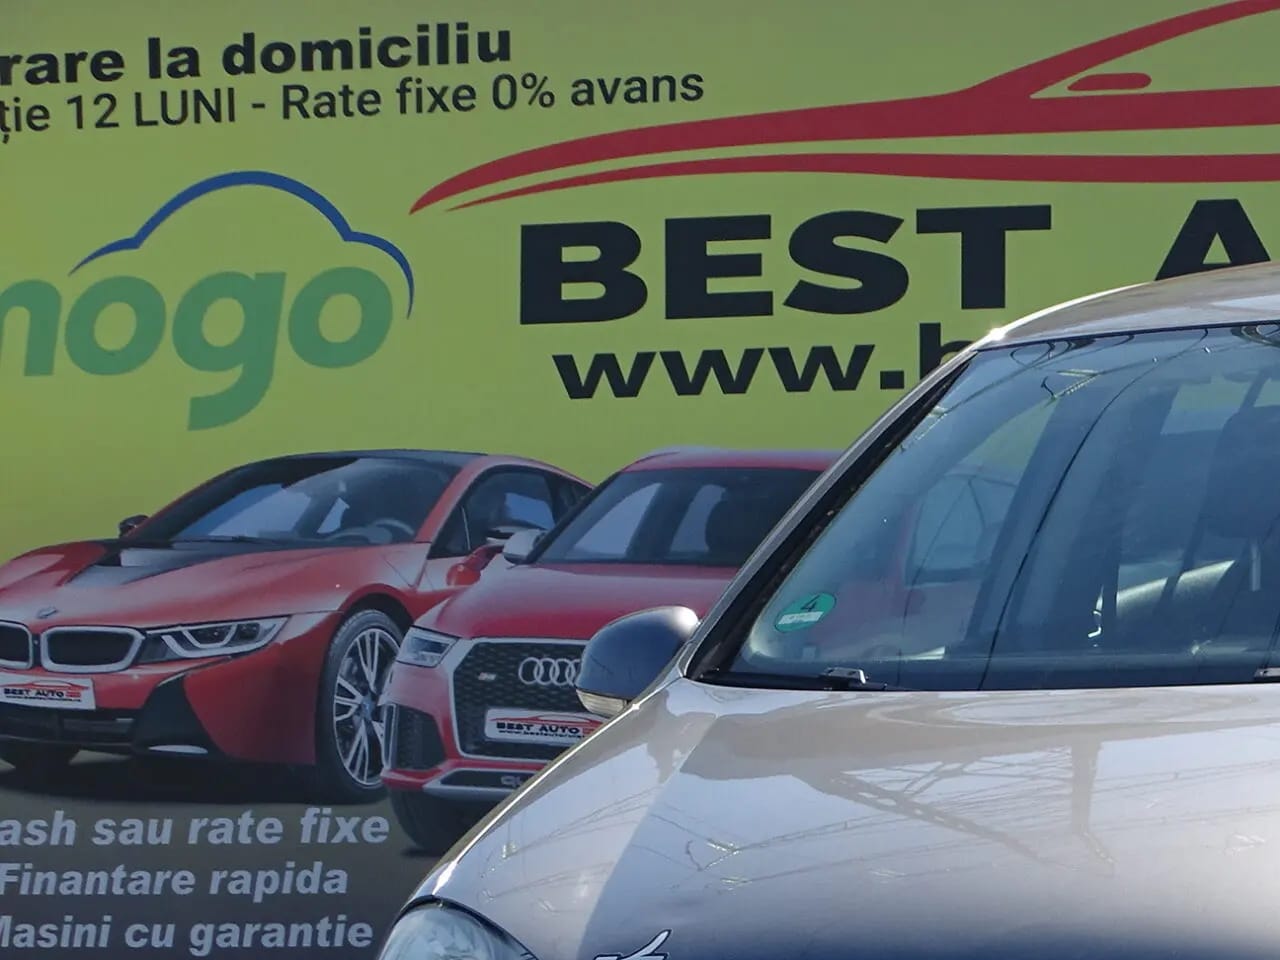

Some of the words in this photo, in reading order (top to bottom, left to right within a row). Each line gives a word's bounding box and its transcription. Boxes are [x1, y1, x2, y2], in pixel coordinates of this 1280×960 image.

[148, 37, 200, 80] la
[222, 22, 511, 76] domiciliu
[66, 92, 120, 130] 12
[134, 87, 236, 127] LUNI
[281, 83, 382, 120] Rate
[395, 76, 477, 115] fixe
[492, 72, 556, 110] 0%
[570, 73, 705, 107] avans
[520, 205, 1052, 326] BEST
[92, 818, 173, 846] sau
[188, 810, 284, 845] rate
[301, 807, 390, 844] fixe
[0, 863, 196, 896] Finantare
[209, 861, 348, 903] rapida
[124, 923, 176, 948] cu
[188, 914, 374, 957] garantie
